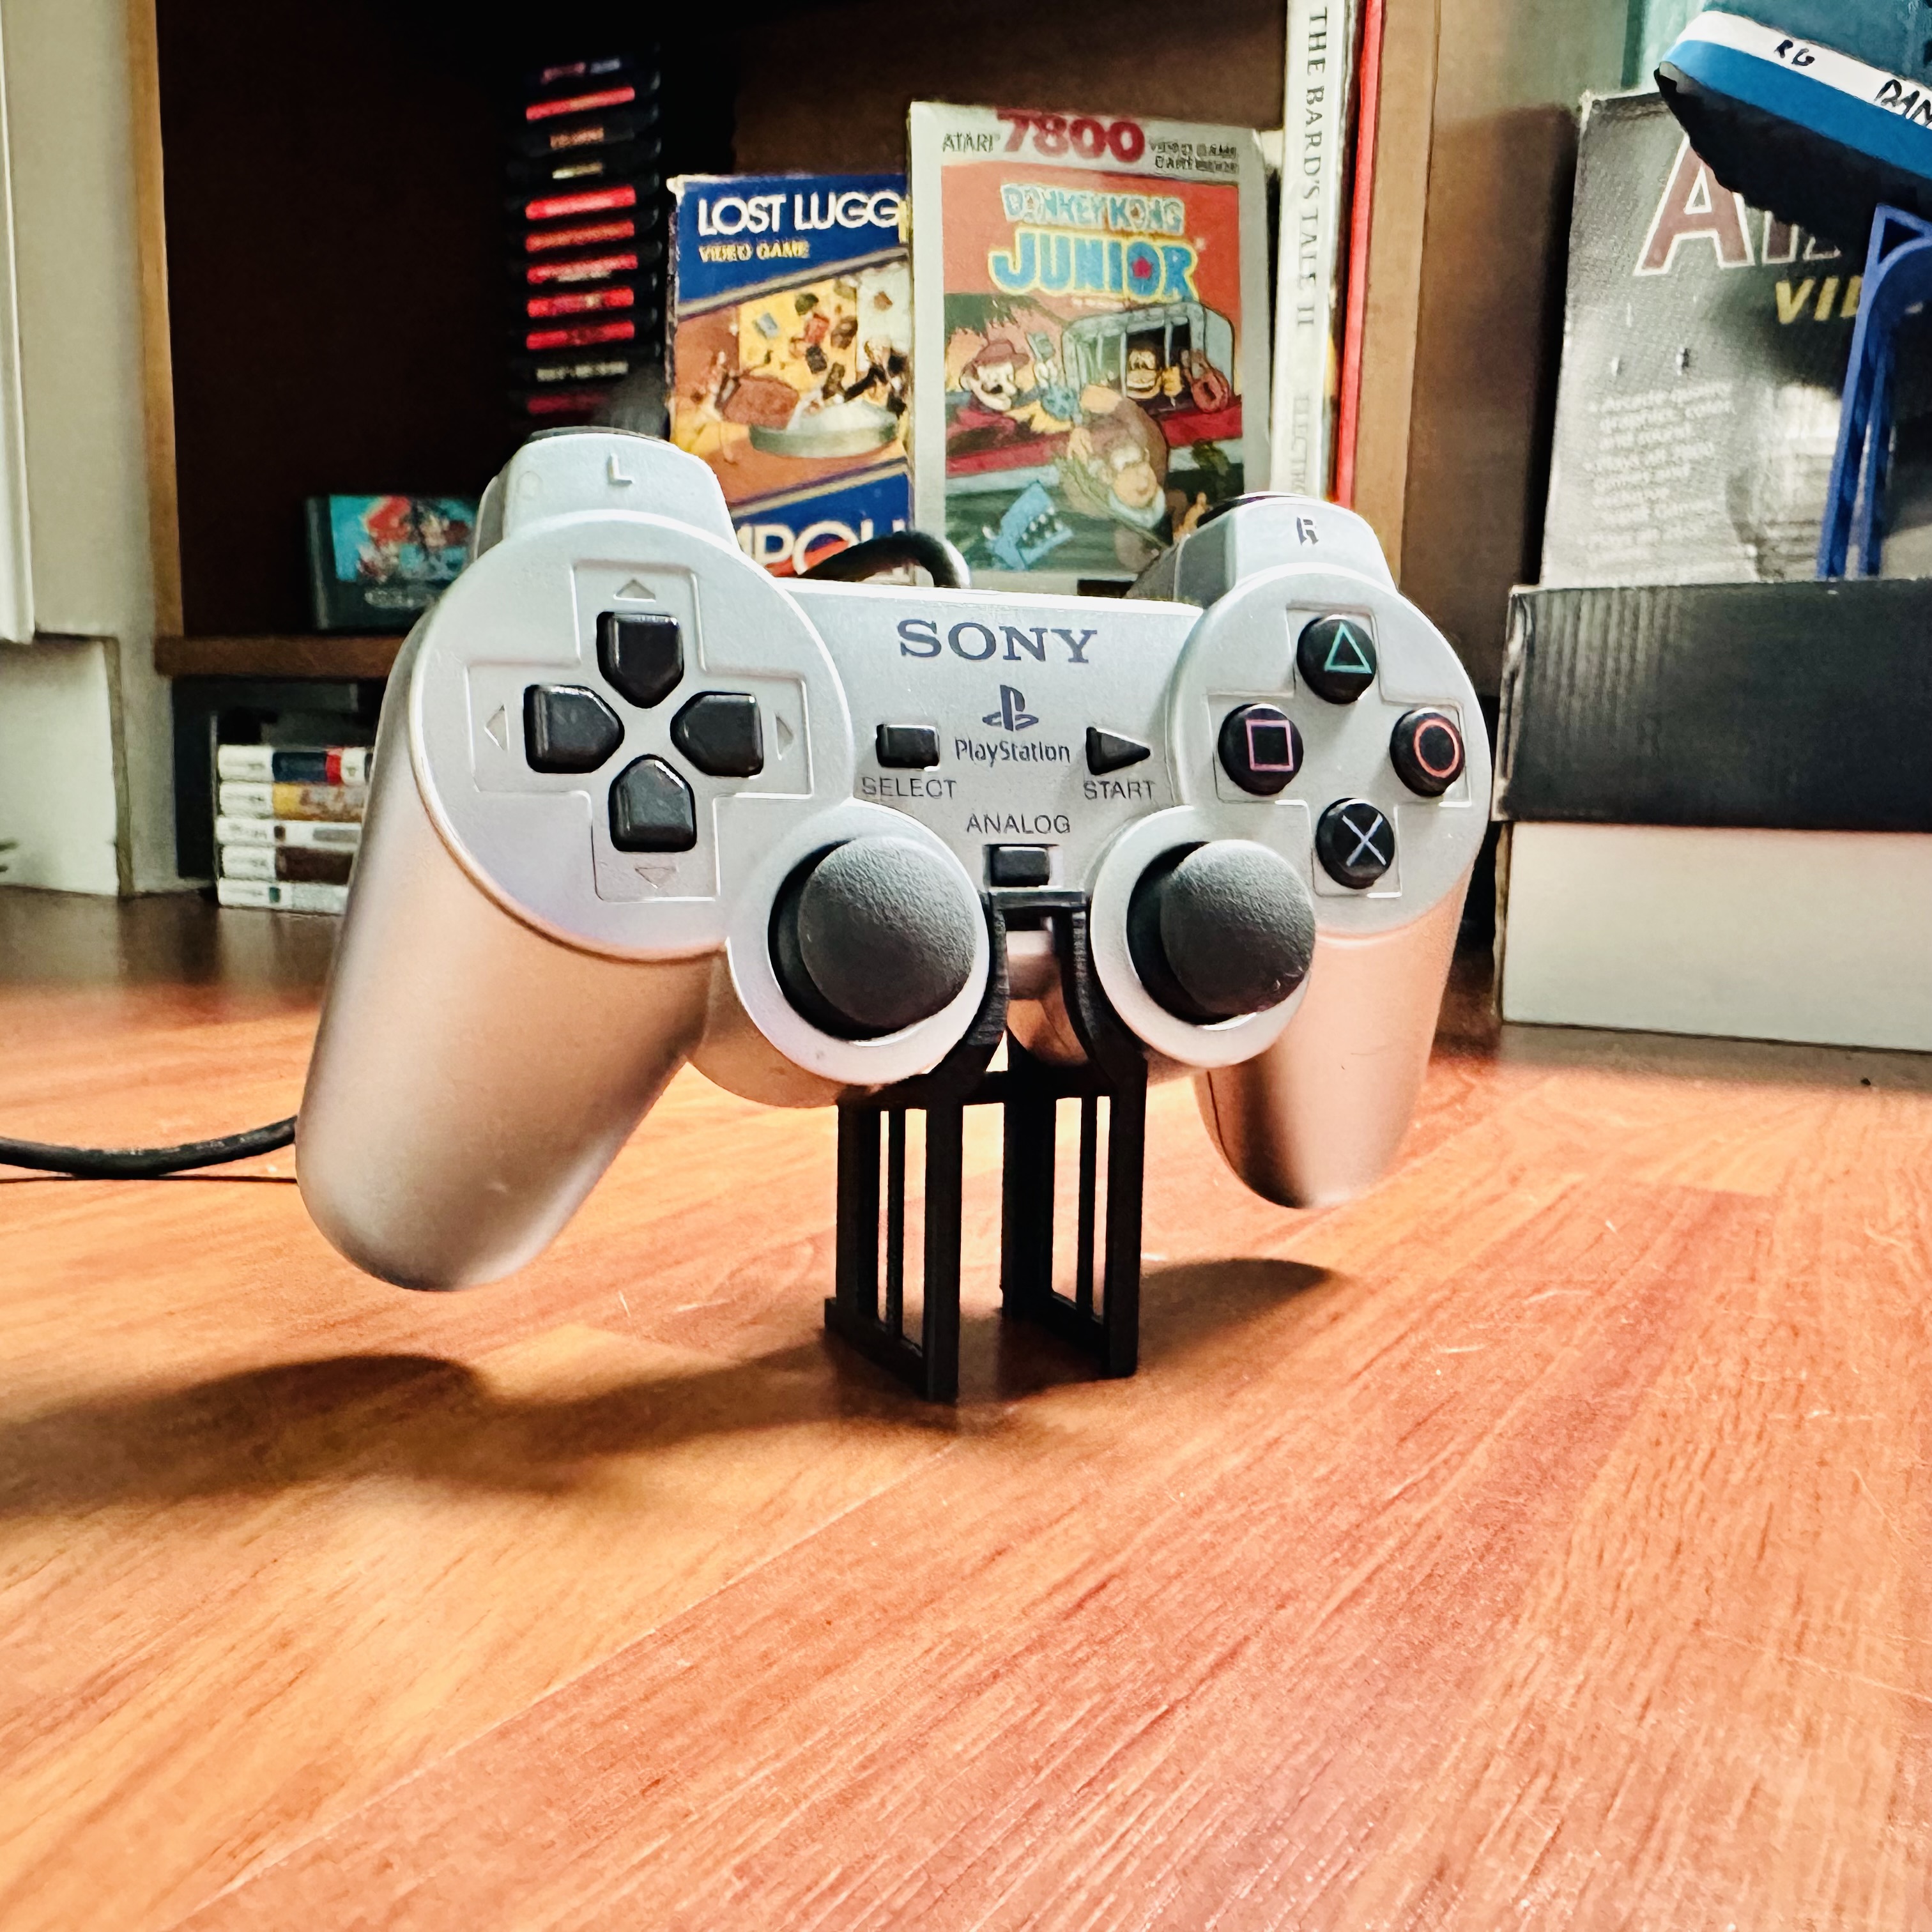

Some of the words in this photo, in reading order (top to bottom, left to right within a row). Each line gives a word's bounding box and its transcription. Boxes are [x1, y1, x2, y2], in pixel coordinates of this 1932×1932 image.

[1307, 6, 1328, 76] THE
[942, 132, 993, 153] ATARI
[997, 107, 1146, 163] 7800
[1303, 85, 1324, 200] BARD'S
[698, 193, 787, 236] LOST
[1001, 184, 1107, 229] DONKEY
[1108, 193, 1184, 235] KONG
[756, 240, 810, 261] GAME
[988, 226, 1200, 302] JUNIOR
[1299, 208, 1318, 289] TALE
[1296, 306, 1315, 326] II
[606, 452, 633, 486] L
[1296, 514, 1319, 546] R
[897, 619, 1098, 663] SONY
[954, 737, 1071, 768] PlayStation
[861, 776, 957, 800] SELECT
[1083, 779, 1156, 802] START
[965, 813, 1071, 835] ANALOG
